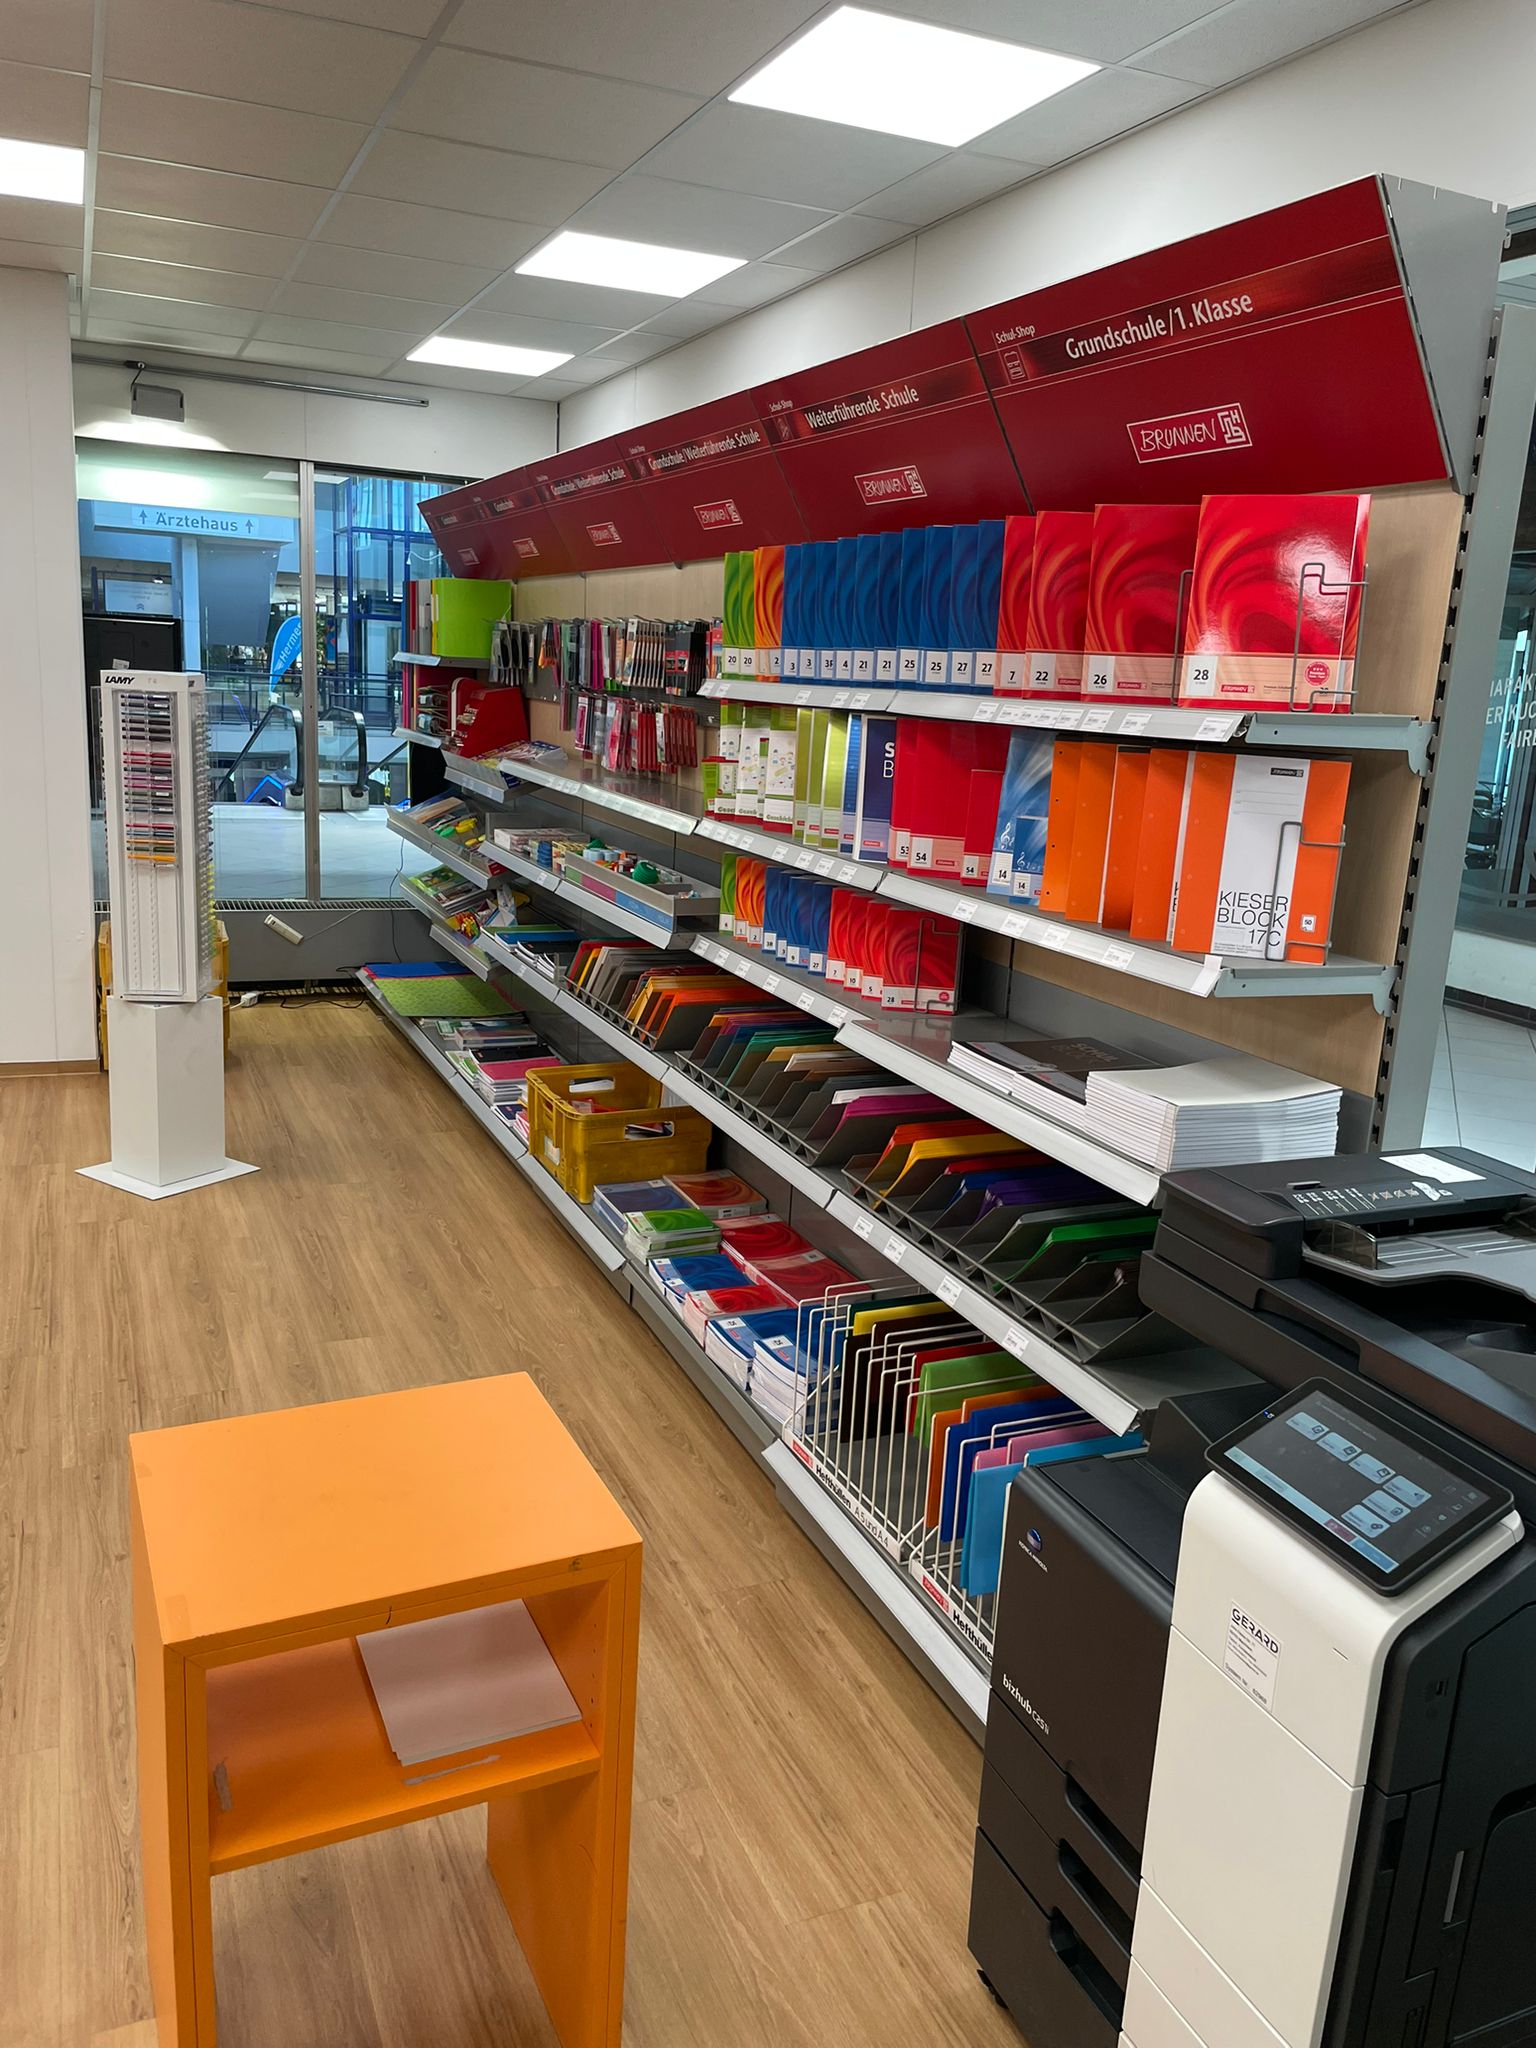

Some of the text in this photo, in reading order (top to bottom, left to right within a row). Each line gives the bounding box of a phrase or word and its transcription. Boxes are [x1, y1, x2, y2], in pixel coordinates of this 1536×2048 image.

[1193, 293, 1254, 326] Klasse
[995, 324, 1036, 345] Schul-Shop
[804, 385, 920, 429] Weiterführende Schule
[735, 429, 761, 448] Schule
[1140, 417, 1218, 454] BRUNNEN
[863, 475, 907, 498] BRUNNEN
[156, 511, 238, 532] Ärztehaus
[859, 660, 868, 669] 21
[882, 660, 891, 669] 21
[904, 660, 915, 668] 25
[930, 662, 942, 671] 25
[957, 662, 968, 672] 27
[982, 663, 992, 672] 27
[105, 676, 135, 685] LAMY
[1035, 670, 1048, 681] 22
[1093, 674, 1108, 685] 26
[1194, 669, 1209, 680] 28
[1507, 701, 1536, 722] KUC
[915, 852, 927, 862] 54
[966, 866, 974, 874] 54
[998, 870, 1007, 880] 14
[1219, 890, 1289, 912] KIESER
[1217, 907, 1284, 929] BLOCK
[816, 1464, 852, 1509] Hefthüllen
[952, 1609, 993, 1663] Hefthülle
[1232, 1608, 1279, 1654] GERARD
[1003, 1673, 1032, 1715] bizhub
